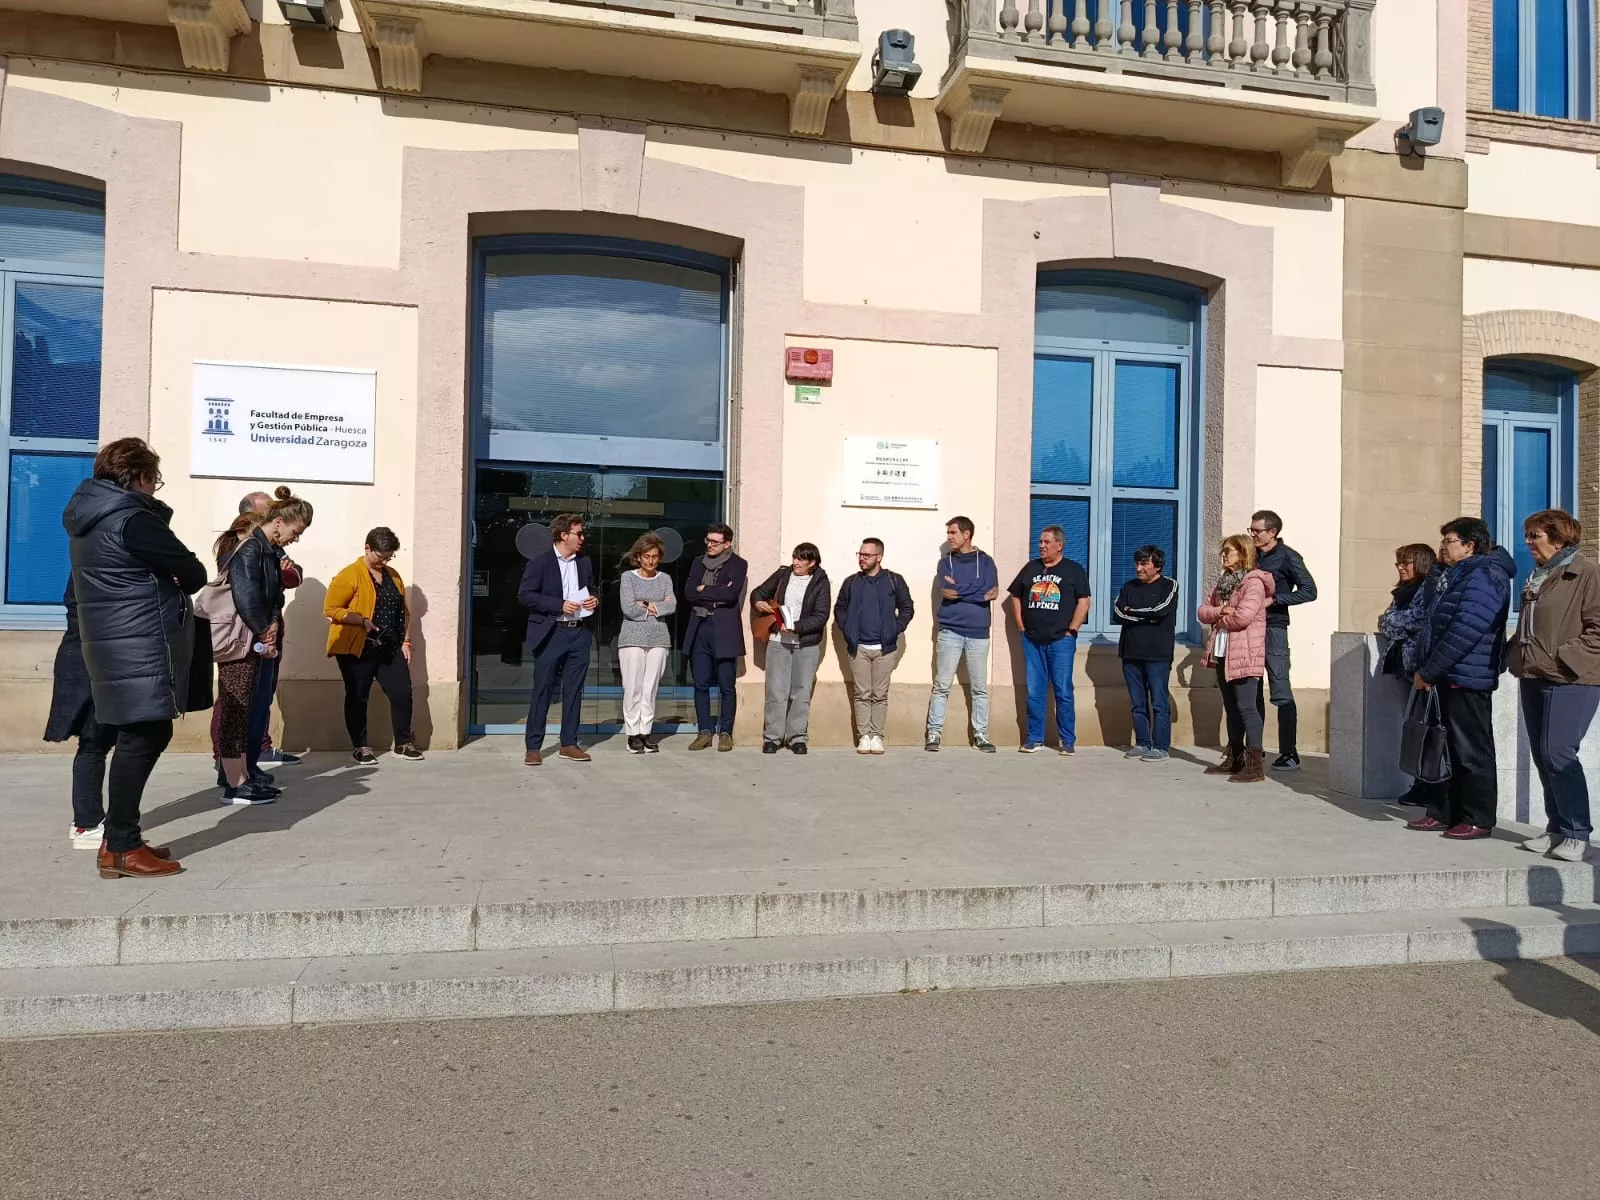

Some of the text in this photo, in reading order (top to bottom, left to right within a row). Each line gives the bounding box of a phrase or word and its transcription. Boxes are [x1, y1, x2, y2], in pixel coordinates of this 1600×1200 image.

[250, 409, 344, 423] Facultad de Empresa
[249, 422, 256, 430] y
[257, 421, 293, 431] Gestión
[294, 423, 328, 433] Pública
[335, 425, 367, 435] Huesca
[250, 432, 367, 449] Universidad Zaragoza
[1028, 601, 1059, 610] LA PINZA
